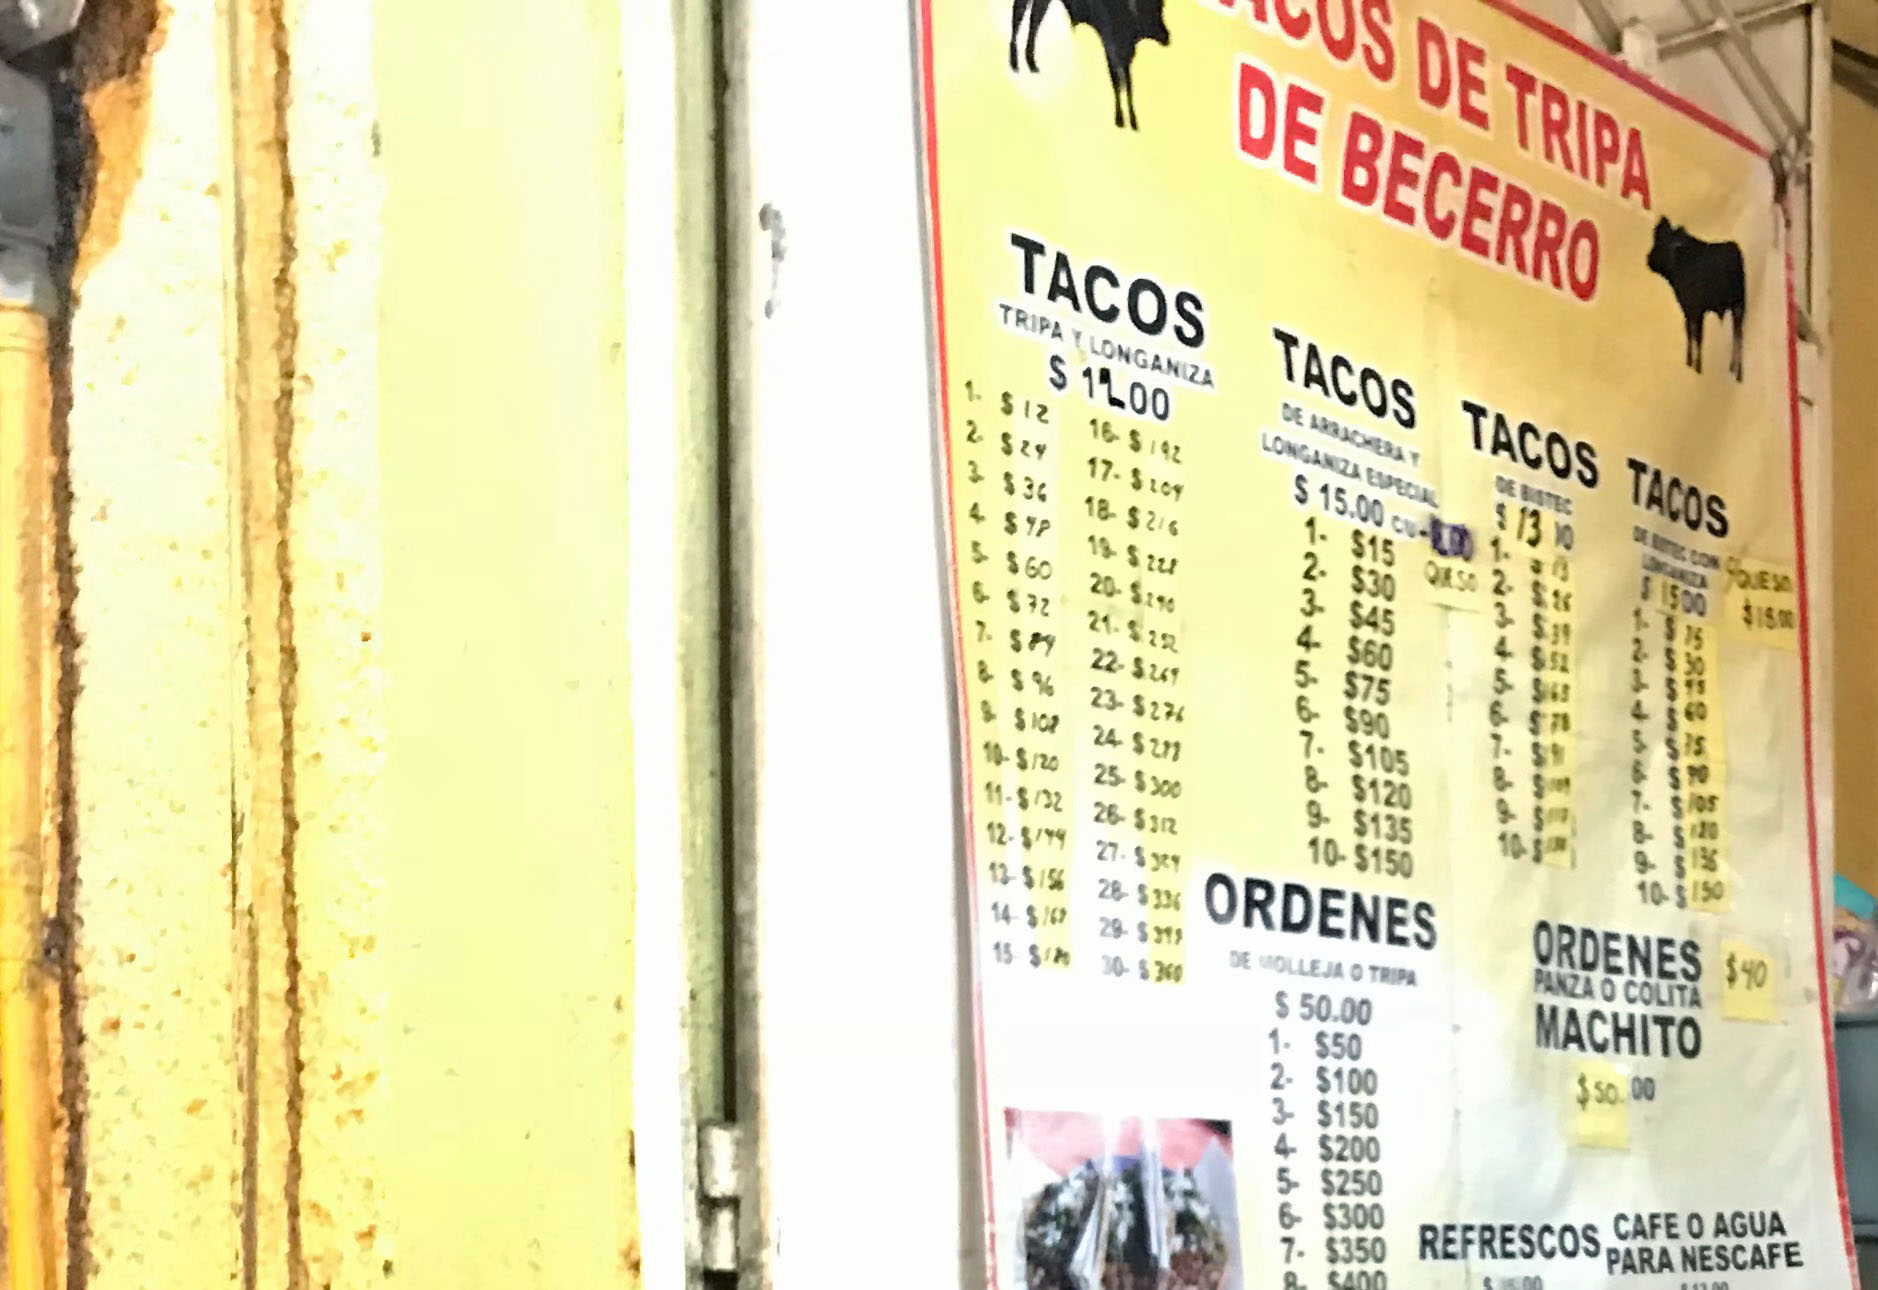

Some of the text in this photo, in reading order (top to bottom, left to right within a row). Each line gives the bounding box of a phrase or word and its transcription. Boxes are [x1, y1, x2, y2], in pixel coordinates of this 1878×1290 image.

[1416, 16, 1490, 131] DE
[1505, 63, 1652, 210] TRIPA
[1239, 62, 1599, 302] DE BECERRO
[1011, 233, 1205, 348] TACOS
[1000, 303, 1063, 341] TRIPA
[1090, 336, 1214, 389] LONGANIZA
[1272, 327, 1416, 430] TACOS
[1282, 402, 1303, 427] DE
[1310, 413, 1406, 463] ARRACHERA
[1461, 400, 1600, 489] TACOS
[1262, 432, 1439, 509] LONGANIZA ESPECIAL
[1294, 474, 1383, 528] $ 15.00
[1627, 457, 1729, 538] TACOS
[1352, 528, 1395, 568] $15
[1351, 565, 1395, 602] $30
[1350, 600, 1395, 637] $45
[1347, 635, 1393, 671] $60
[1343, 670, 1391, 706] $75
[1344, 705, 1390, 739] $90
[1349, 740, 1409, 777] $105
[1352, 774, 1412, 810] $120
[1354, 808, 1413, 845] $135
[1355, 843, 1414, 879] $150
[1205, 872, 1437, 951] ORDENES
[1230, 950, 1418, 987] DE MOLLEJA O TRIPA
[1533, 920, 1702, 983] ORDENES
[1534, 968, 1702, 1009] PANZA O COLITA
[1275, 990, 1372, 1026] $ 50.00
[1315, 1030, 1362, 1061] $50
[1535, 1003, 1702, 1059] MACHITO
[1316, 1065, 1378, 1096] $100
[1317, 1099, 1379, 1129] $150
[1318, 1134, 1381, 1163] $200
[1321, 1168, 1383, 1196] $250
[1323, 1203, 1384, 1230] $300
[1613, 1210, 1787, 1242] CAFE O AGUA
[1325, 1236, 1387, 1264] $350
[1419, 1223, 1600, 1260] REFRESCOS
[1607, 1242, 1804, 1276] PARA NESCAFE
